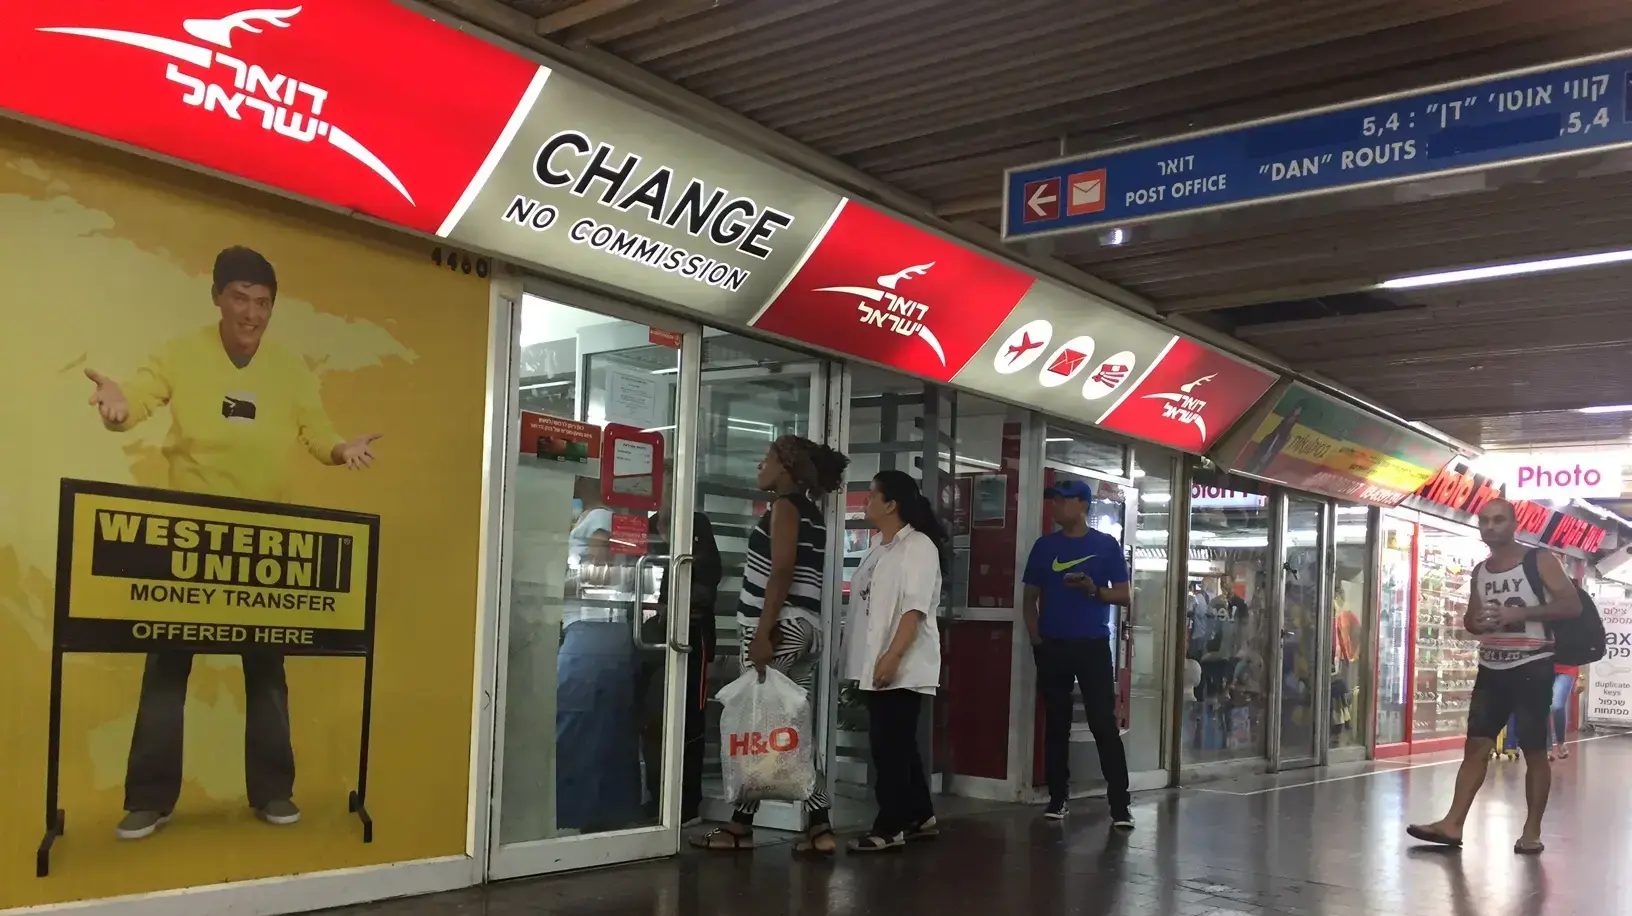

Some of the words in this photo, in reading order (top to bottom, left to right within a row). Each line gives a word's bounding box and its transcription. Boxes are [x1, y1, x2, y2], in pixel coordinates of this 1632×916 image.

[215, 51, 328, 116] דואר
[1564, 74, 1610, 102] קווי
[166, 63, 330, 143] ישראל
[1362, 112, 1400, 136] 5,4
[1156, 155, 1195, 177] דואר
[1258, 154, 1333, 182] "DAN"
[1341, 140, 1417, 170] ROUTS
[534, 131, 794, 259] CHANGE
[1125, 184, 1168, 208] POST
[1171, 174, 1227, 201] OFFICE
[503, 195, 558, 231] NO
[570, 219, 751, 291] COMMISSION
[883, 291, 930, 321] דואר
[858, 301, 923, 337] ישראל
[1162, 402, 1202, 426] ישראל
[1180, 394, 1206, 412] דואר
[1518, 464, 1601, 488] Photo
[98, 511, 314, 559] WESTERN
[170, 551, 313, 587] UNION
[130, 583, 217, 605] MONEY
[223, 589, 336, 612] TRANSFER
[1484, 578, 1524, 596] PLAY
[1603, 606, 1627, 615] צילום
[132, 622, 247, 642] OFFERED
[254, 628, 314, 645] HERE
[1605, 632, 1632, 646] ax
[1607, 646, 1631, 660] פק
[1595, 681, 1631, 690] duplicate
[1603, 688, 1622, 697] keys
[1594, 706, 1630, 716] מפתחות
[1598, 697, 1626, 707] שכפול
[729, 726, 799, 757] H&O
